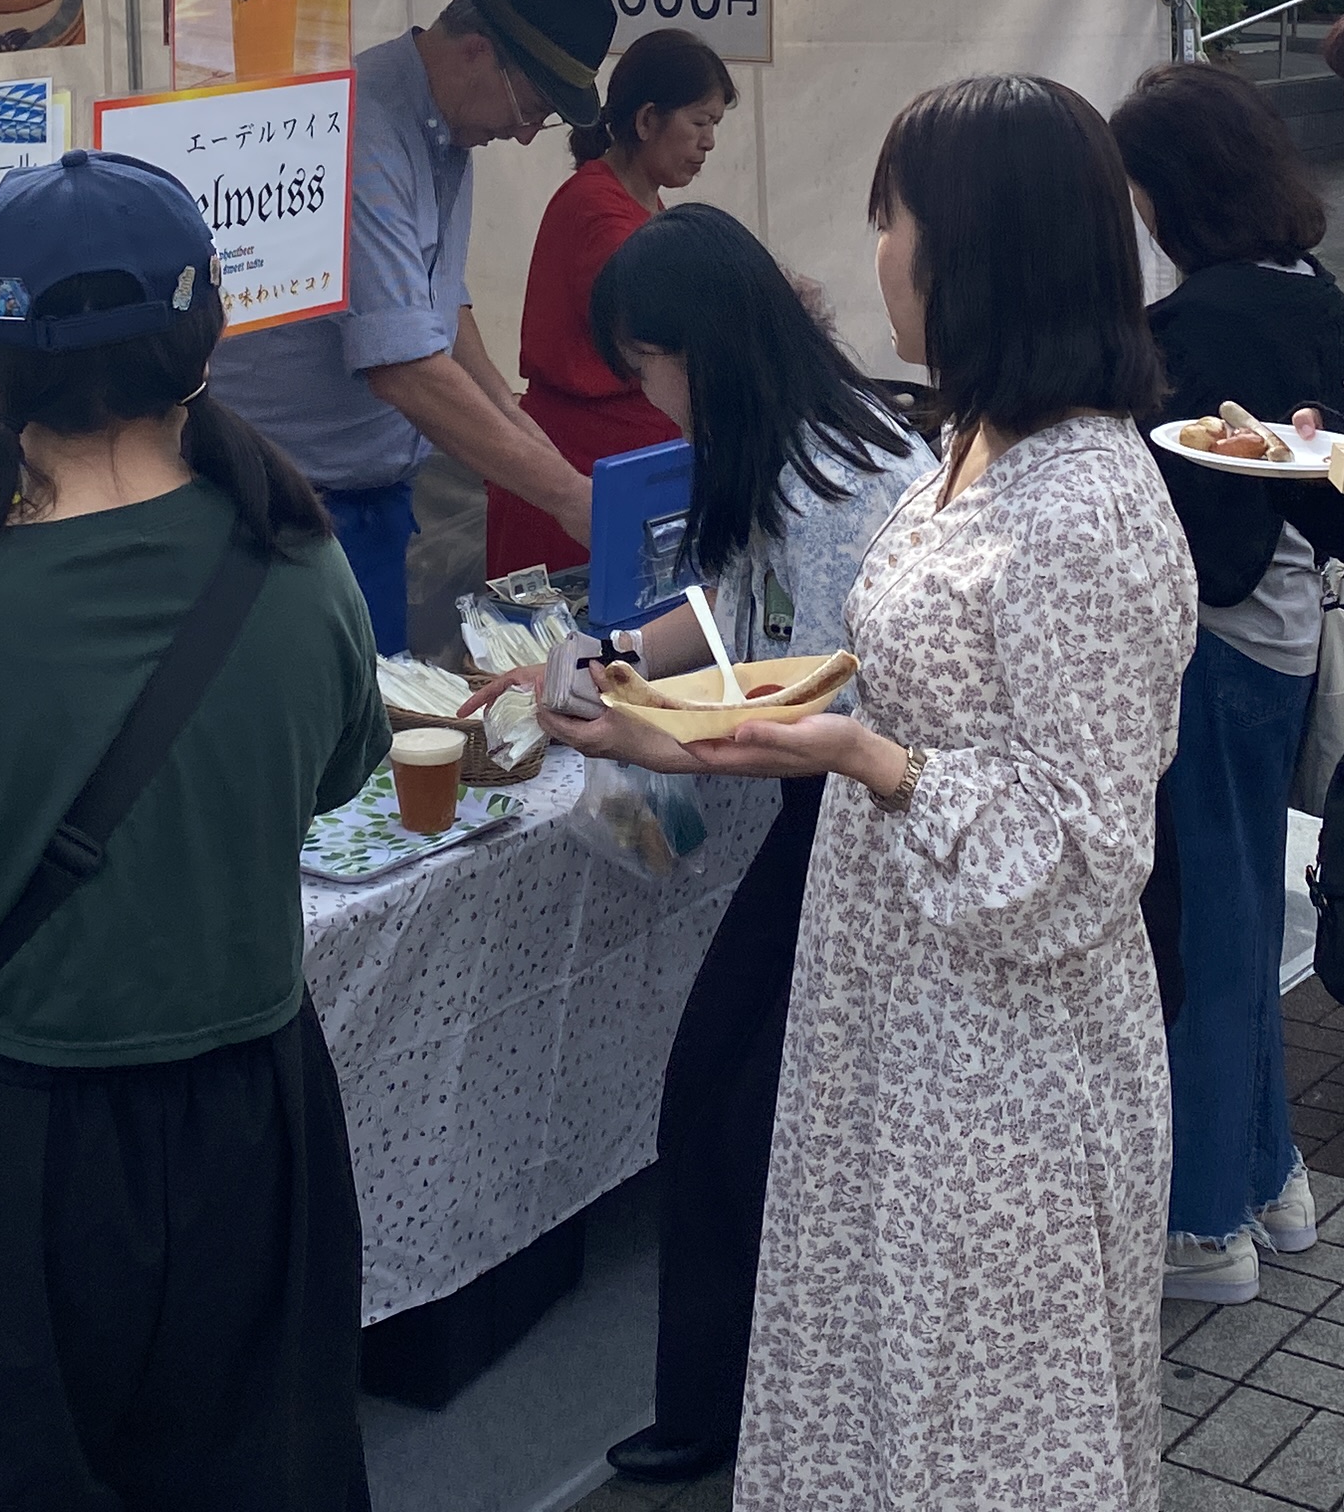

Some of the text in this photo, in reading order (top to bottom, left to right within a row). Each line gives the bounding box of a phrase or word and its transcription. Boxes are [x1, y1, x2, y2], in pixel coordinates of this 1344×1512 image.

[187, 112, 341, 153] エーデルワイス
